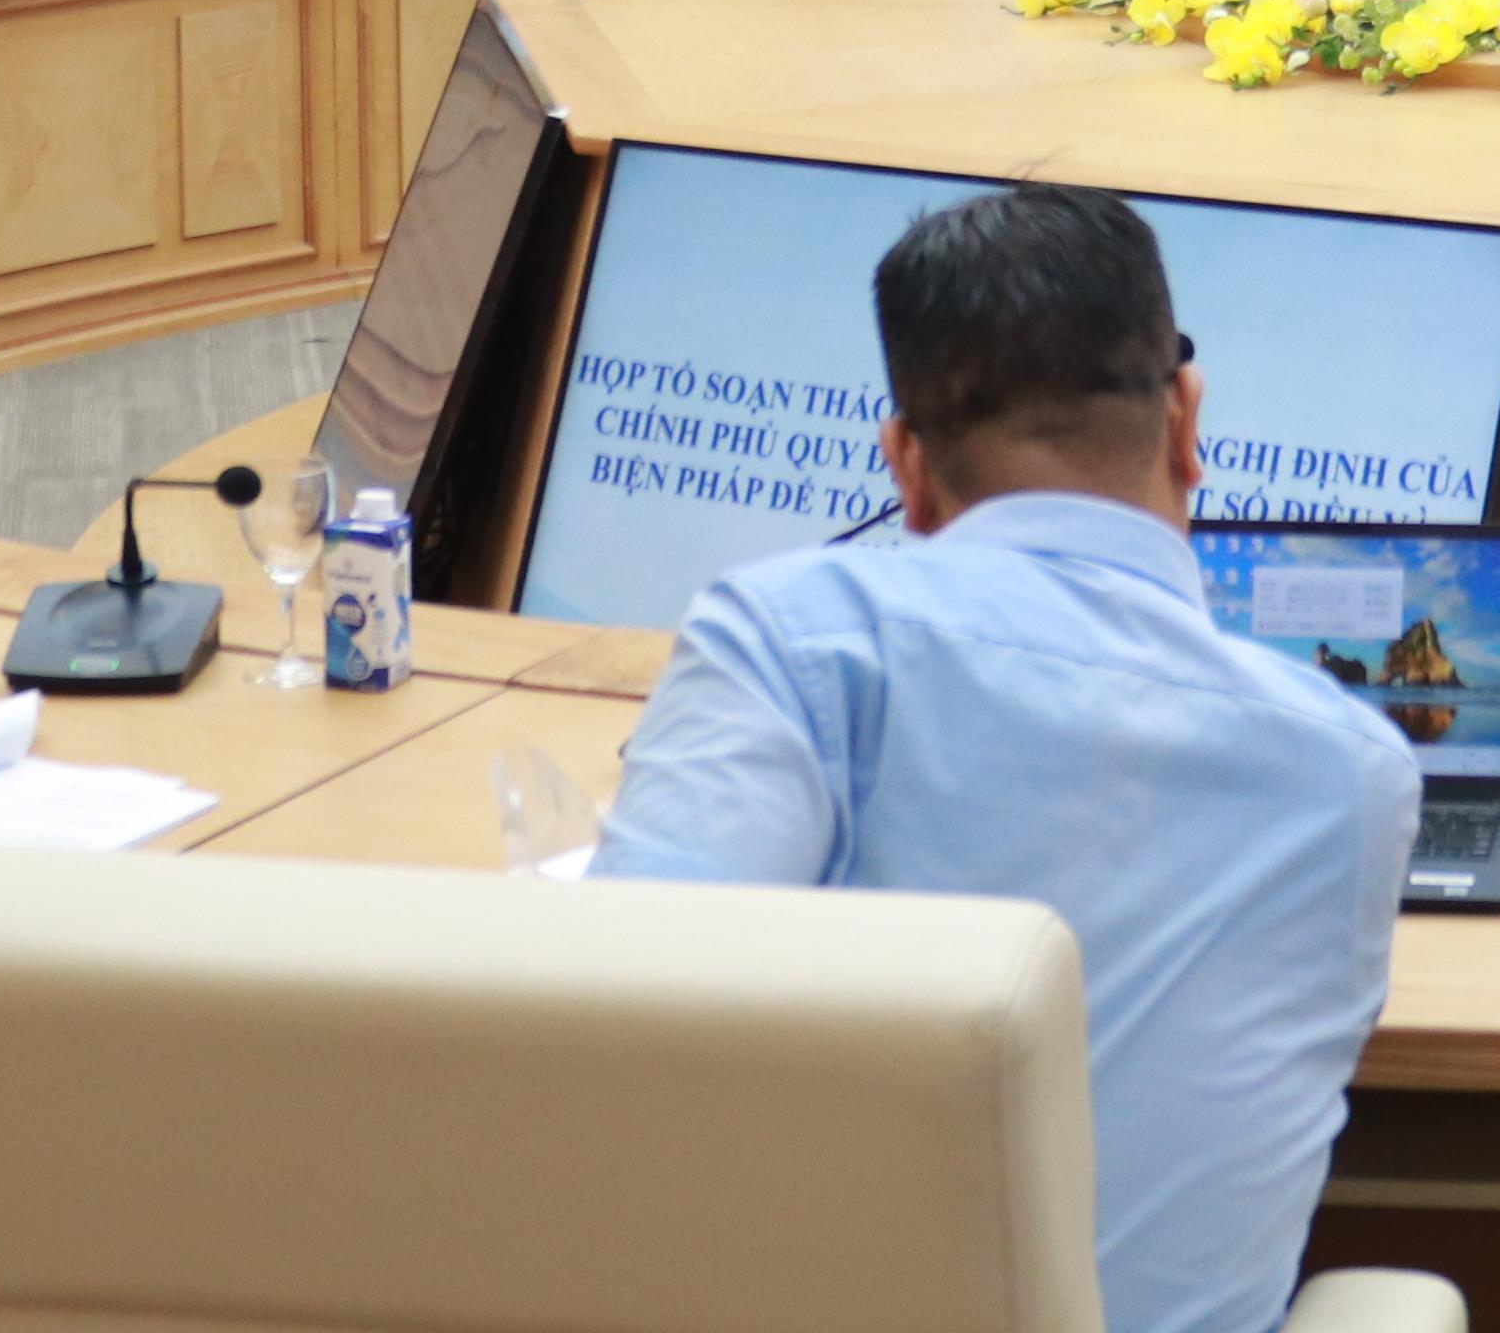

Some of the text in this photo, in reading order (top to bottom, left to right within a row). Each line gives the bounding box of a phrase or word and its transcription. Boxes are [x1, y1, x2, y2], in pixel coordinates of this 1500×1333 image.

[578, 355, 646, 394] HỌP
[653, 359, 695, 397] TỔ
[703, 373, 794, 415] SOẠN
[595, 404, 702, 448] CHÍNH
[710, 420, 779, 458] PHỦ
[787, 433, 860, 471] QUY
[591, 454, 670, 496] BIỆN
[676, 465, 764, 508] PHÁP
[769, 475, 815, 515] ĐỂ
[825, 484, 870, 523] TỔ
[1292, 447, 1389, 490] ĐỊNH
[1399, 455, 1476, 500] CỦA
